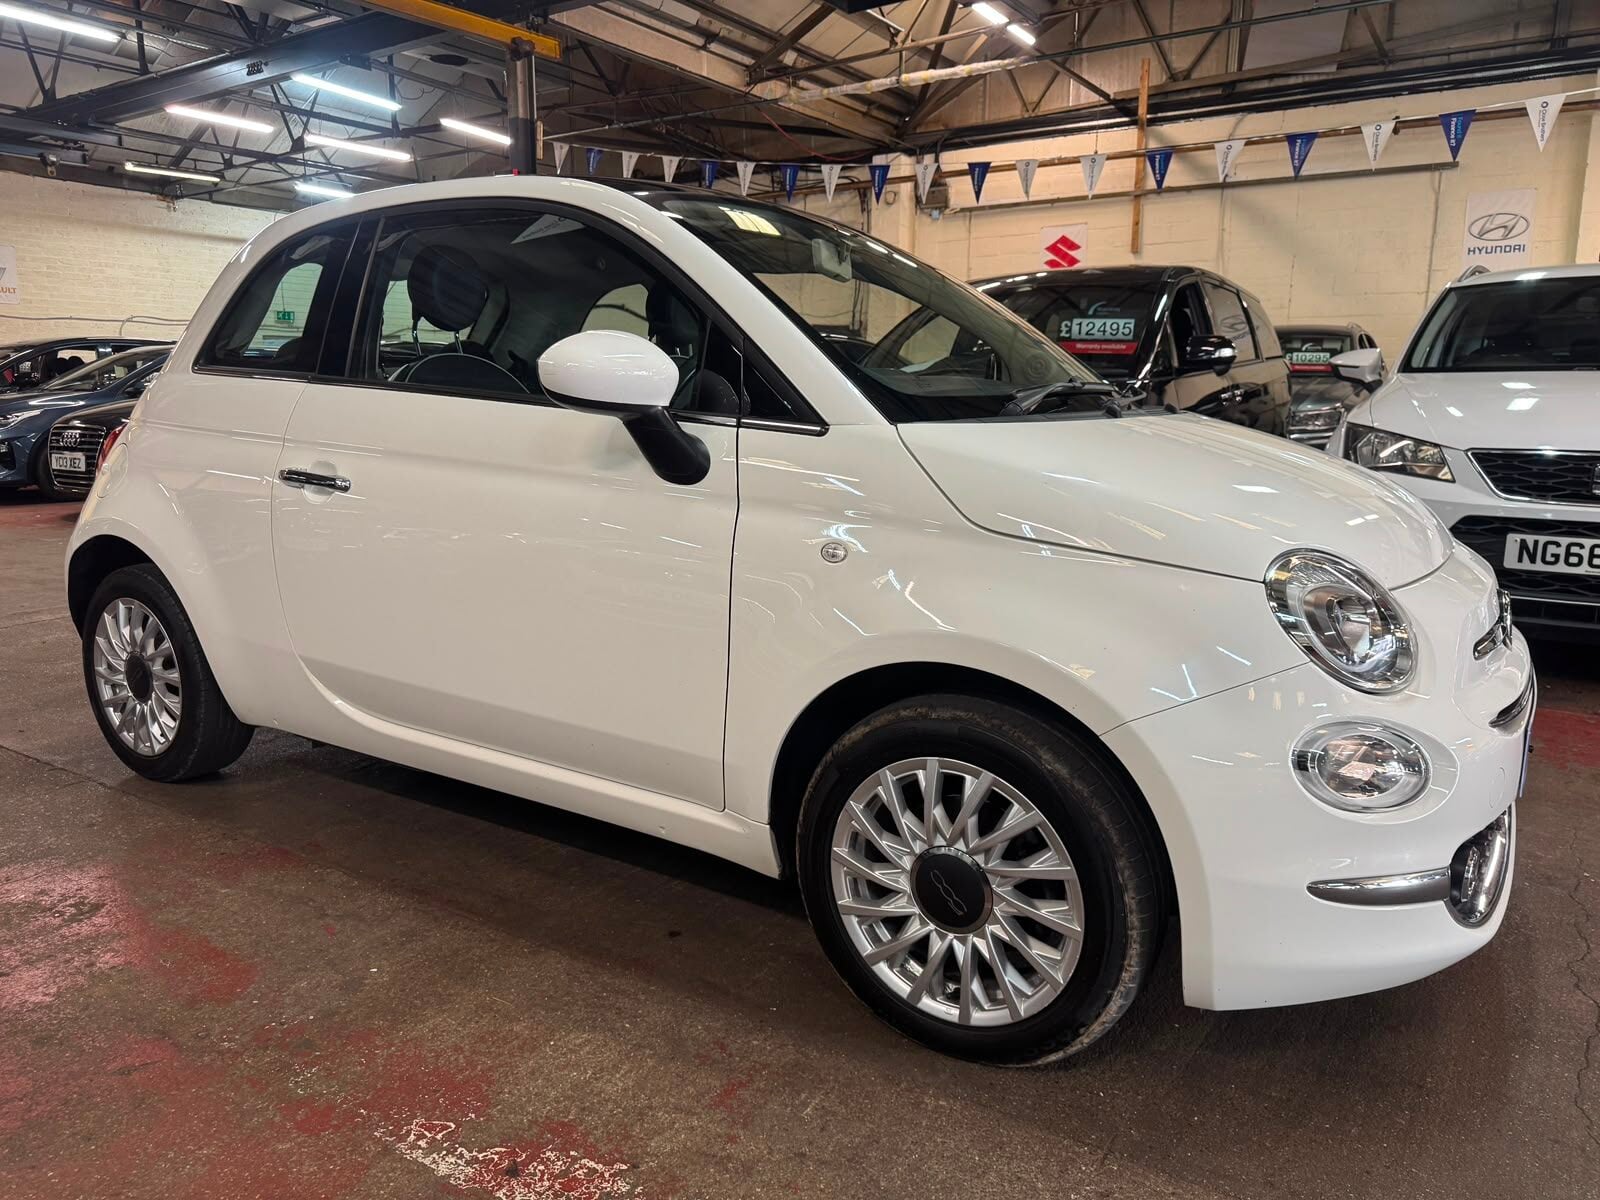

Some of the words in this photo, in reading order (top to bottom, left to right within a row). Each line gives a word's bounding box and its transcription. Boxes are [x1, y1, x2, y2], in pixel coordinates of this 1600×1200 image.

[1467, 244, 1526, 255] HYUNDAI
[1060, 321, 1133, 337] £12495
[69, 457, 82, 469] XEZ
